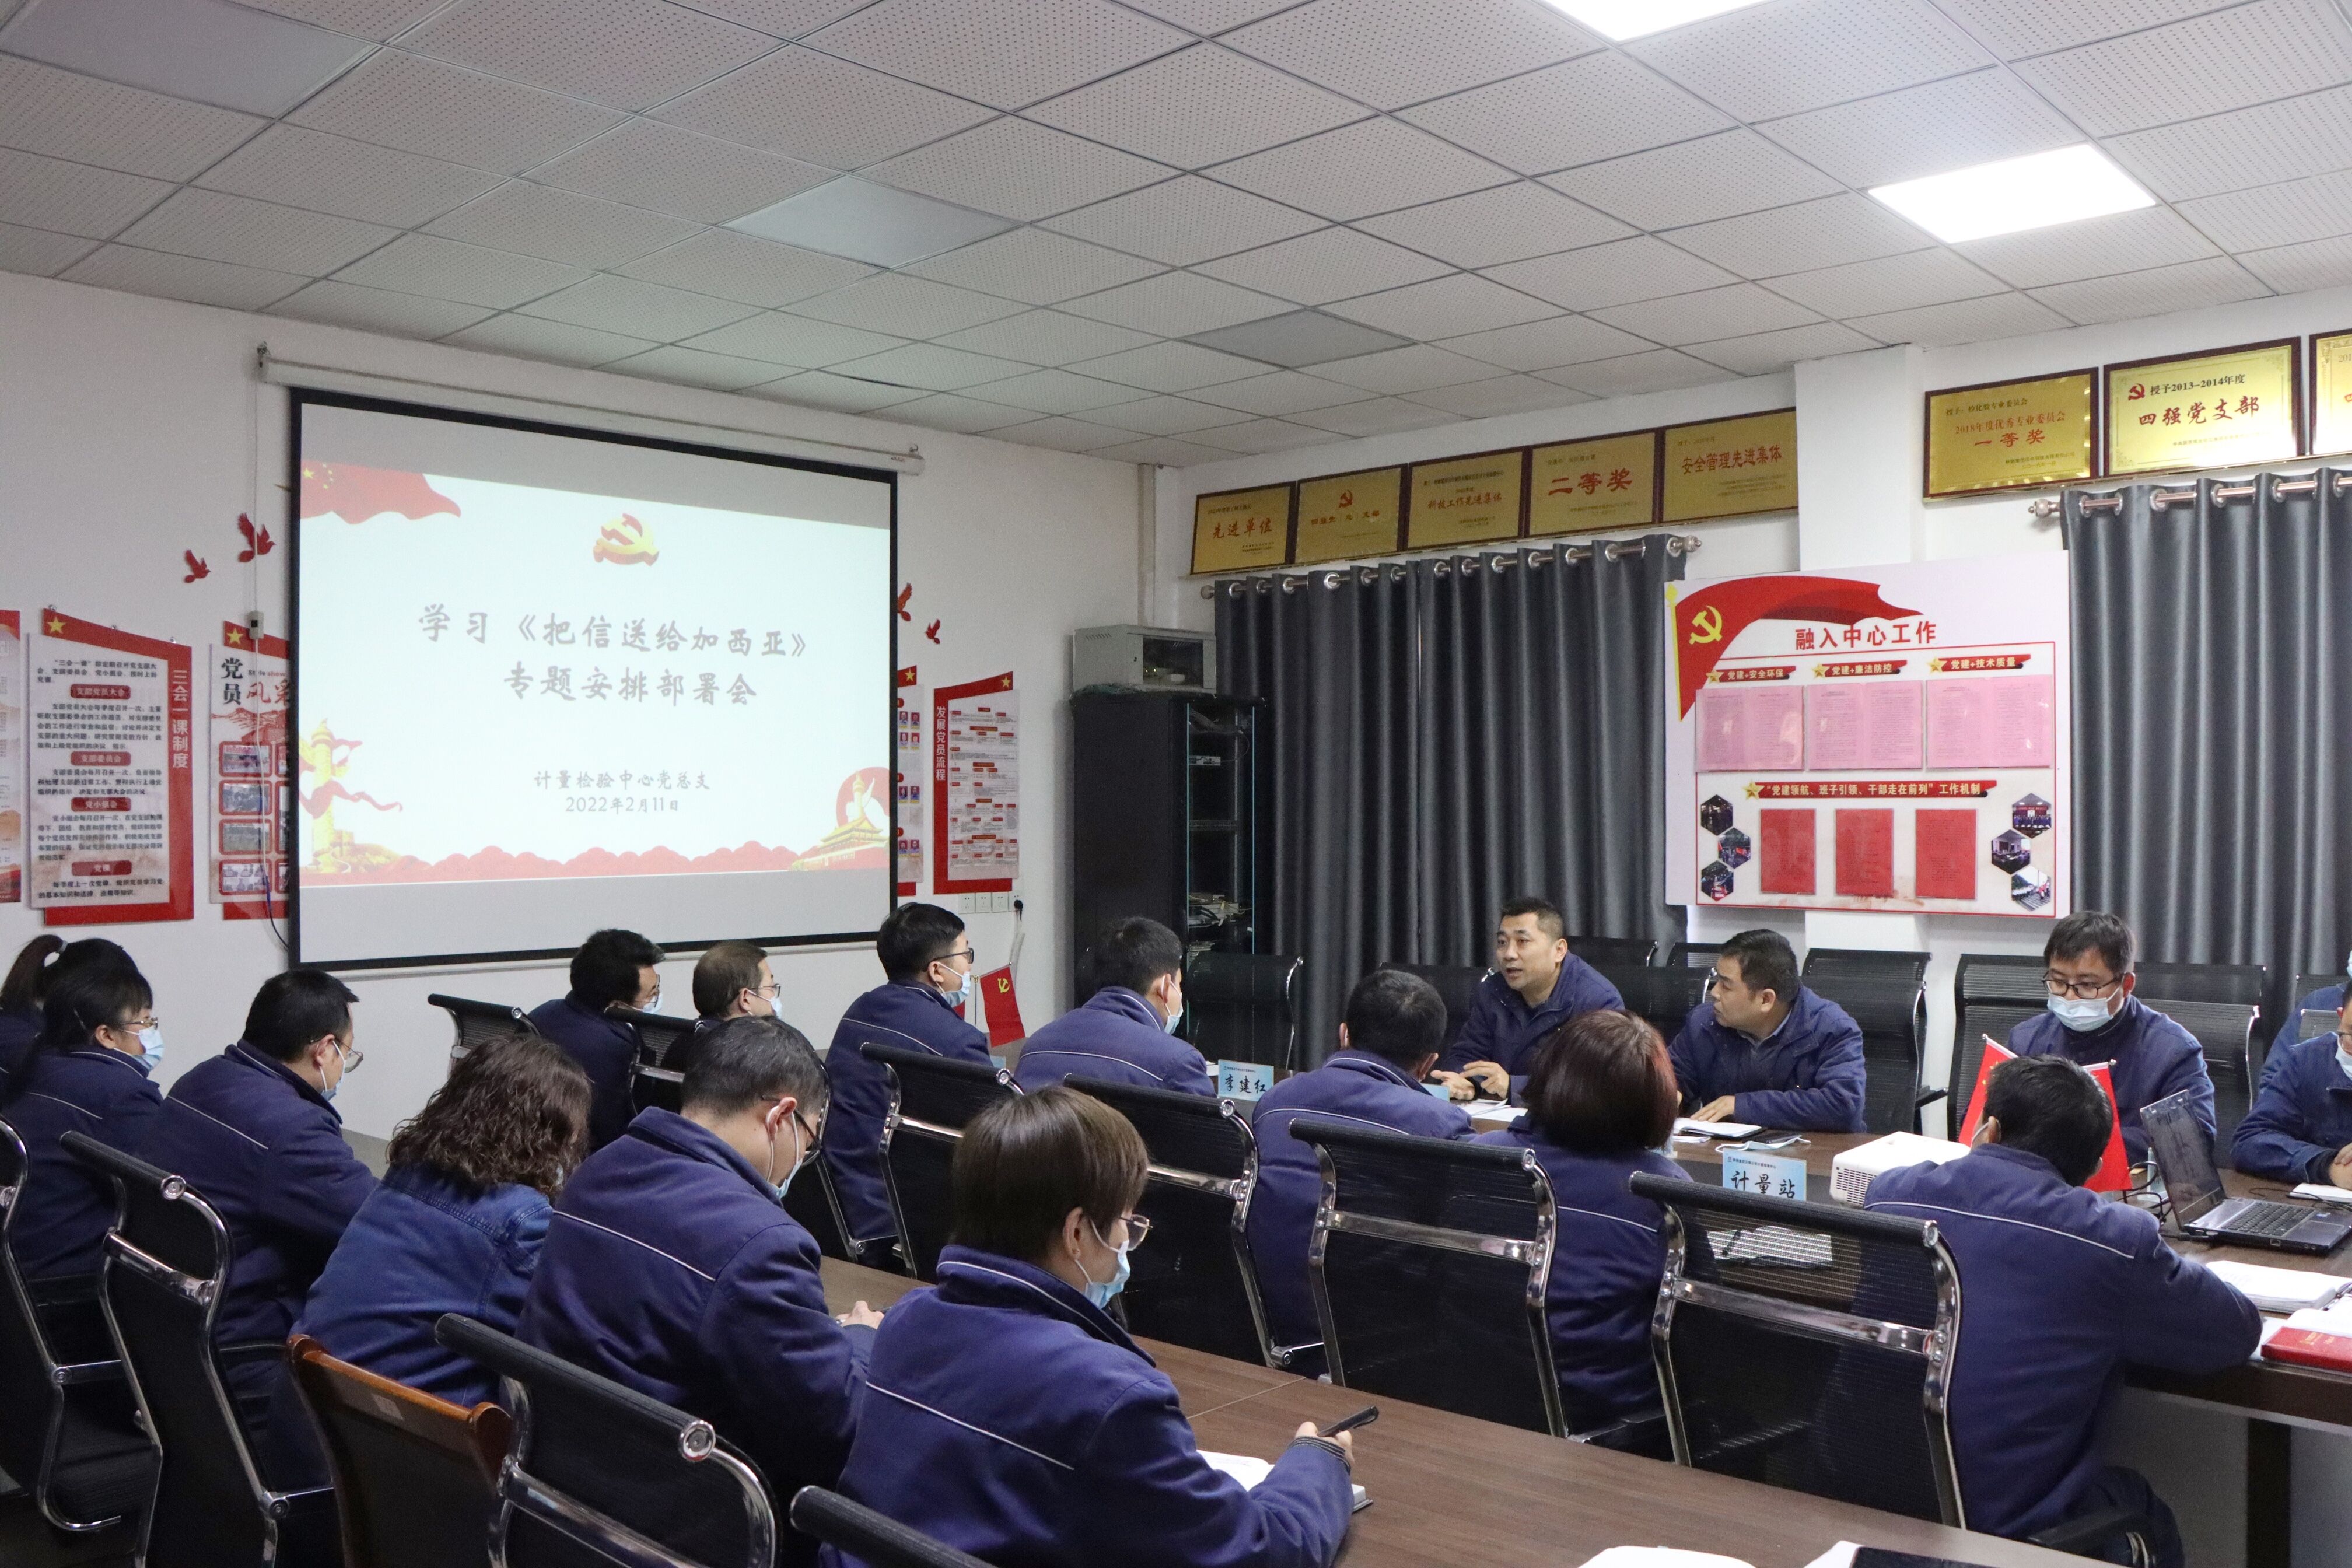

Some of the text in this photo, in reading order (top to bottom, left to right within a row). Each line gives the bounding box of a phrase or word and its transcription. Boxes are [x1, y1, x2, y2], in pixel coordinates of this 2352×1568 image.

[2139, 395, 2259, 426] 四强党支部
[1975, 429, 2045, 447] 一等奖
[1682, 443, 1782, 474] 安全管理先进集体
[1548, 468, 1632, 495] 二等奖
[1213, 517, 1272, 539] 先进单位
[418, 603, 807, 658] 学习《把信送给加西亚》
[1796, 621, 1936, 650] 融入中心工作
[1728, 668, 1785, 680] 党建+安全环保
[1832, 663, 1892, 675] 党建+廉洁防控
[1951, 657, 2016, 669] 党建+技术质量
[77, 688, 125, 696] 支部党员大会
[221, 657, 243, 705] 党员
[503, 661, 757, 706] 专题安排部署会
[173, 670, 188, 768] 三会一课制度
[936, 706, 946, 780] 发展党员流程
[534, 770, 710, 791] 计量检验中心党总支
[565, 796, 679, 814] 2022年2月11日
[1225, 1074, 1266, 1093] 李建红
[1731, 1171, 1795, 1199] 计量站
